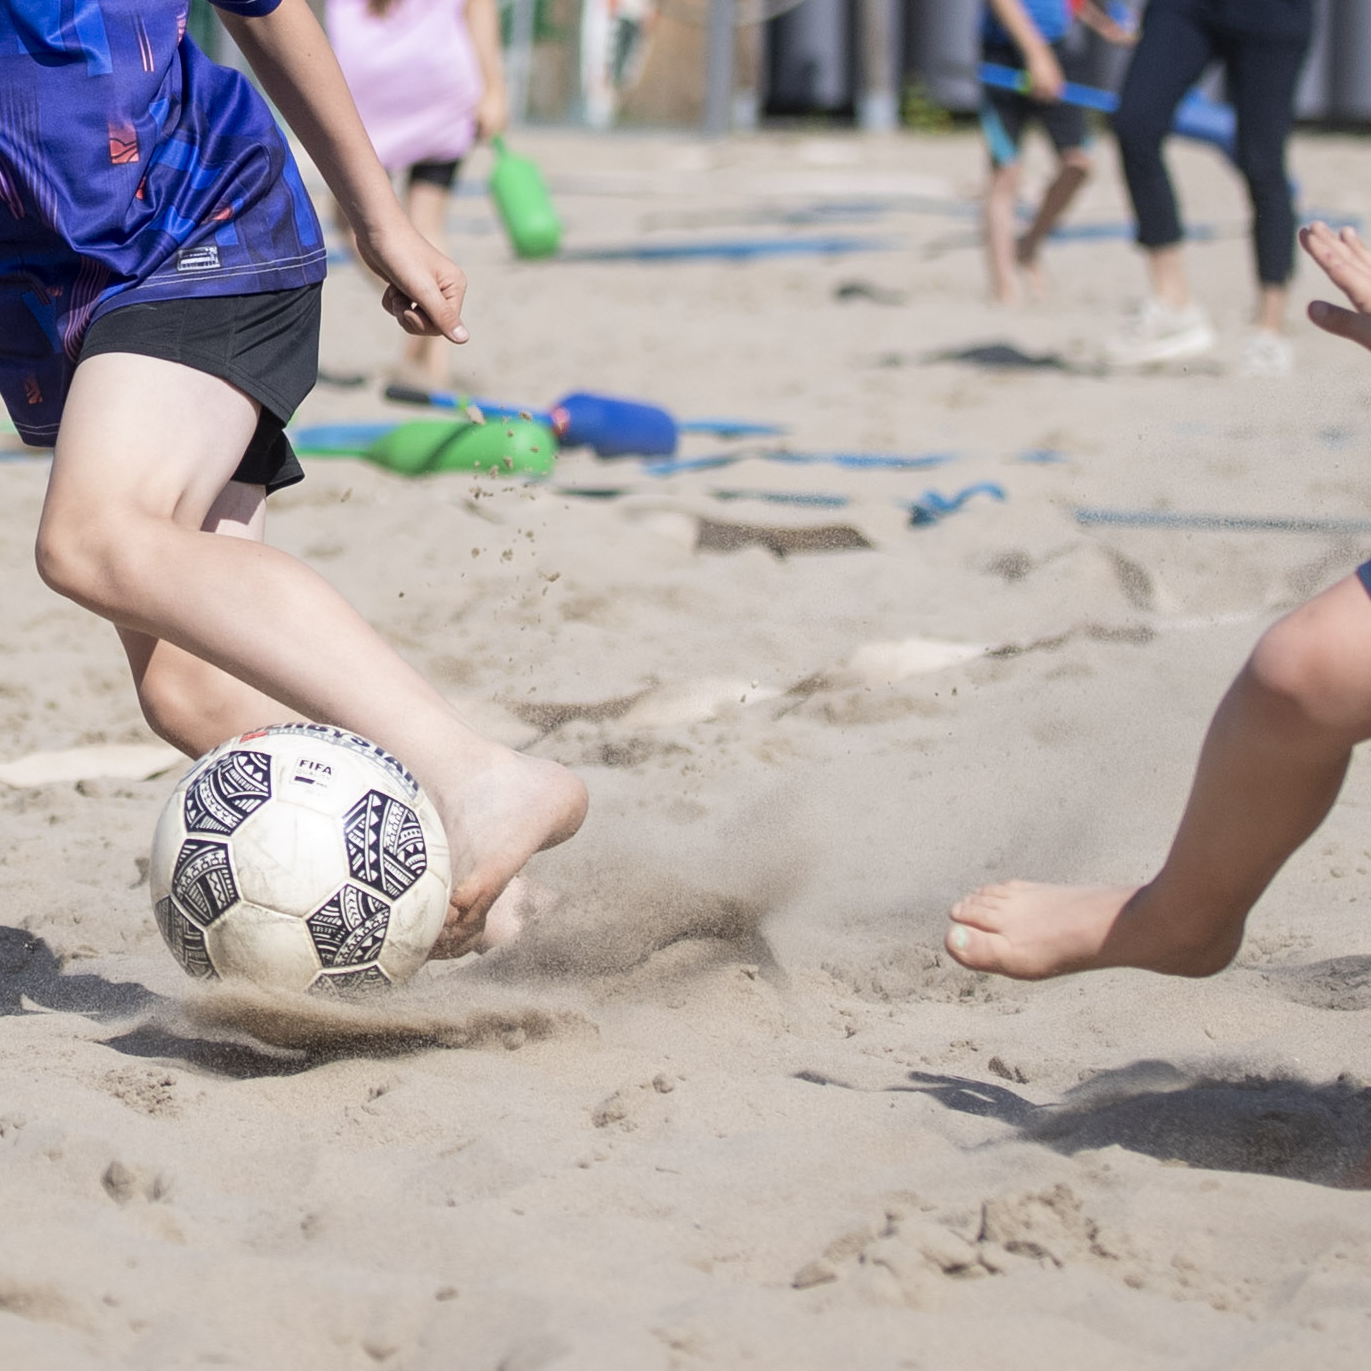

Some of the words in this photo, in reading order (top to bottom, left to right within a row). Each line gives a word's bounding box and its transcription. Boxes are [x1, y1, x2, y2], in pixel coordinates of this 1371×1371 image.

[269, 728, 346, 746] BRILLANT
[243, 722, 419, 792] BYSTA
[299, 759, 332, 775] FIFA
